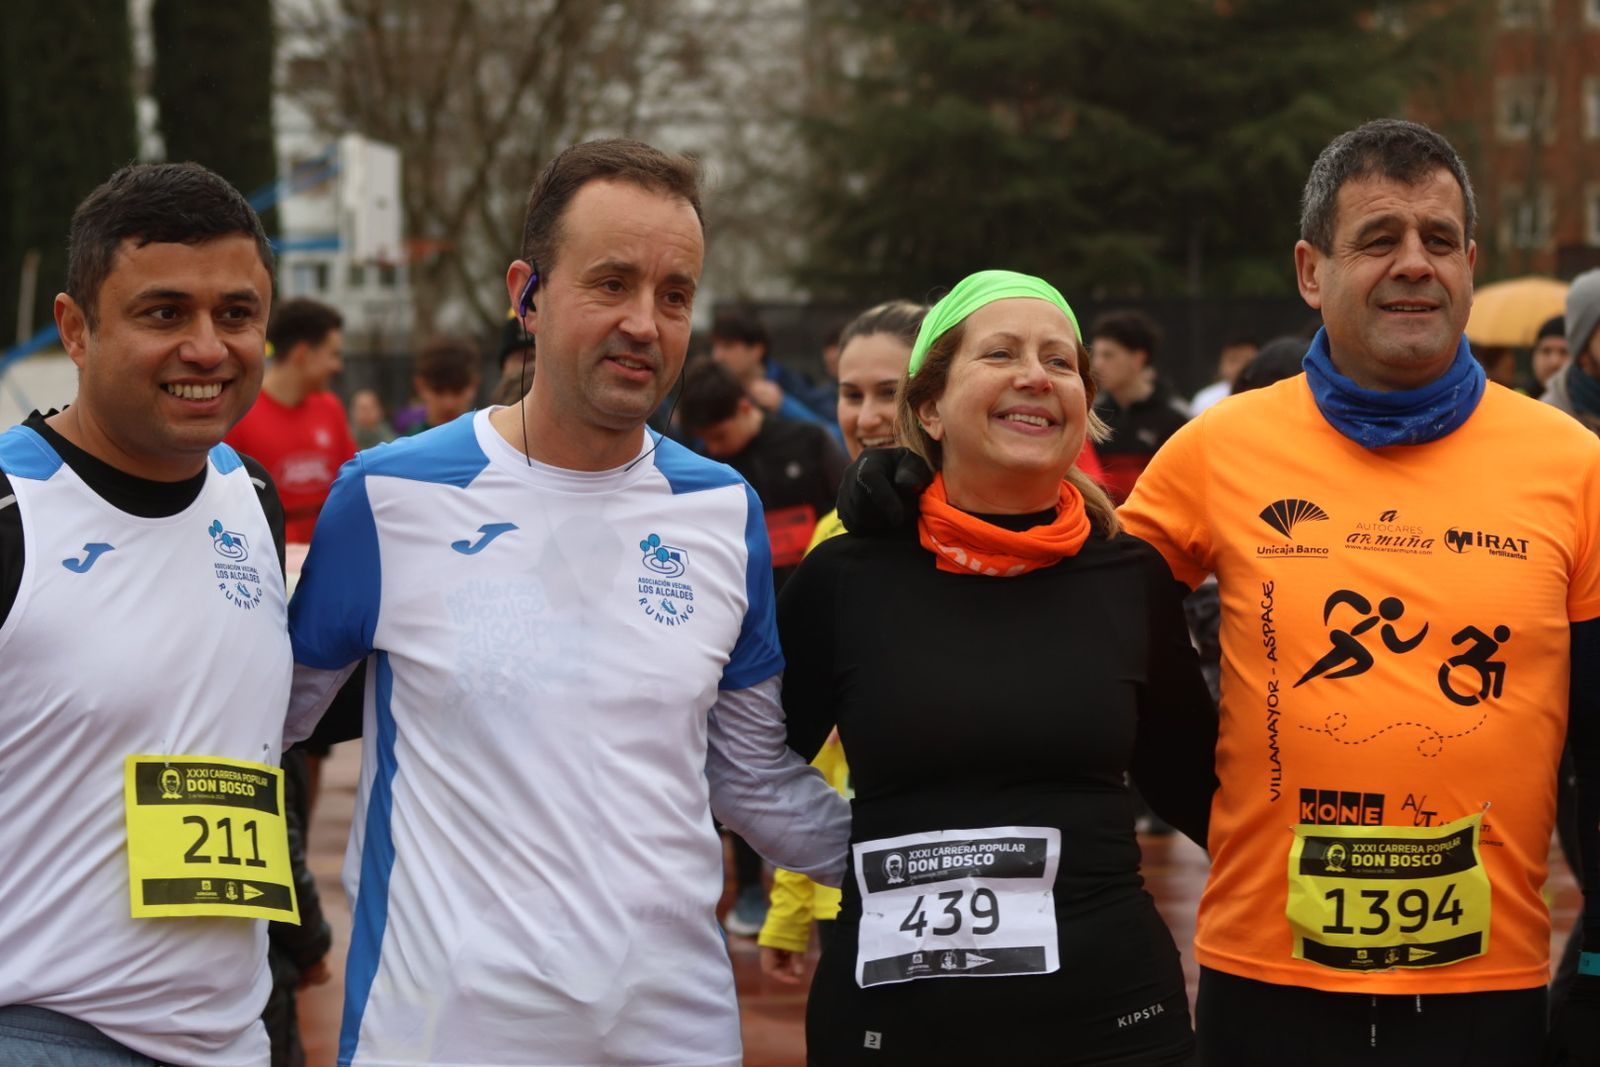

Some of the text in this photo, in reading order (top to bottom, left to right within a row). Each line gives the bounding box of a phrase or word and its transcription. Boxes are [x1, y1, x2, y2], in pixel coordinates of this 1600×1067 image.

[1356, 523, 1424, 534] AUTOCARES
[1257, 544, 1329, 555] Unicaja Banco
[1489, 549, 1527, 560] fertilizantes
[216, 570, 260, 584] LOS ALCALDES
[219, 583, 262, 610] RUNNING
[638, 584, 694, 601] LOS ALCALDES
[639, 597, 694, 626] RUNNING
[1261, 580, 1277, 662] ASPACE
[1267, 679, 1282, 802] VILLAMAYOR
[186, 769, 269, 787] XXXI CARRERA POPULAR
[186, 779, 217, 792] DON
[219, 781, 255, 797] BOSCO
[1301, 801, 1382, 824] KONE
[183, 815, 267, 868] 211
[1352, 837, 1462, 853] XXXI CARRERA POPULAR
[909, 843, 1026, 860] XXXI CARRERA POPULAR
[1352, 853, 1442, 867] DON BOSCO
[908, 853, 994, 874] DON BOSCO
[899, 887, 1000, 938] 439
[1322, 883, 1464, 936] 1394
[1117, 1003, 1165, 1028] KIPSTA
